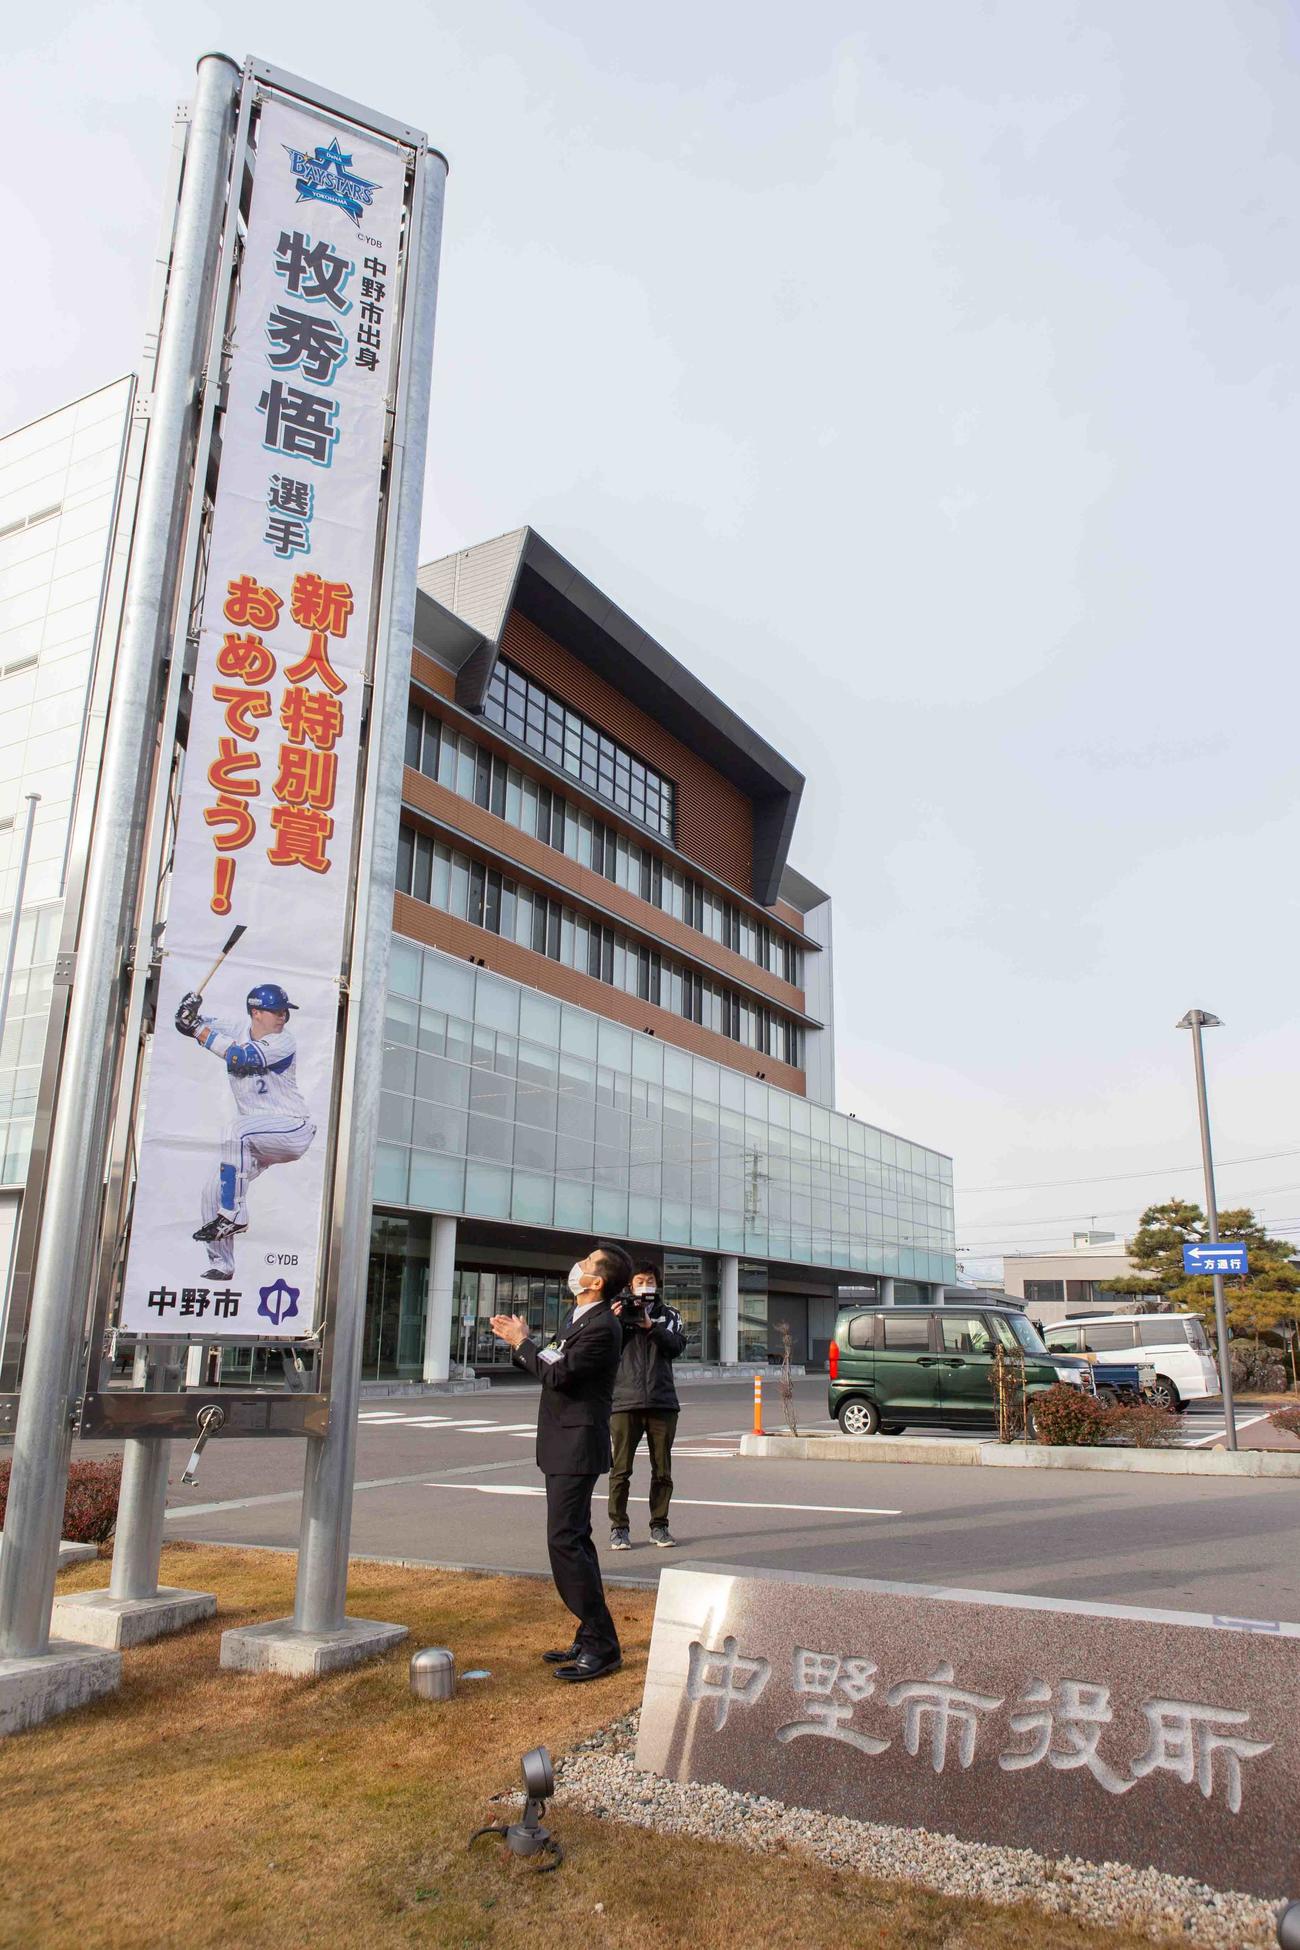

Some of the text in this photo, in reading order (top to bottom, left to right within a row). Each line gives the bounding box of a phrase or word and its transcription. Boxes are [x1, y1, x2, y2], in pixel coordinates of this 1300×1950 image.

[290, 151, 374, 206] BAYSTARS
[312, 191, 348, 206] YOKOHAMA
[355, 257, 387, 371] 中野市出身
[267, 571, 353, 874] 新人特別賞
[256, 1079, 268, 1094] 2
[1191, 1258, 1241, 1270] 一方通行
[148, 1286, 242, 1318] 中野市
[688, 1635, 1273, 1814] 中野市役所
